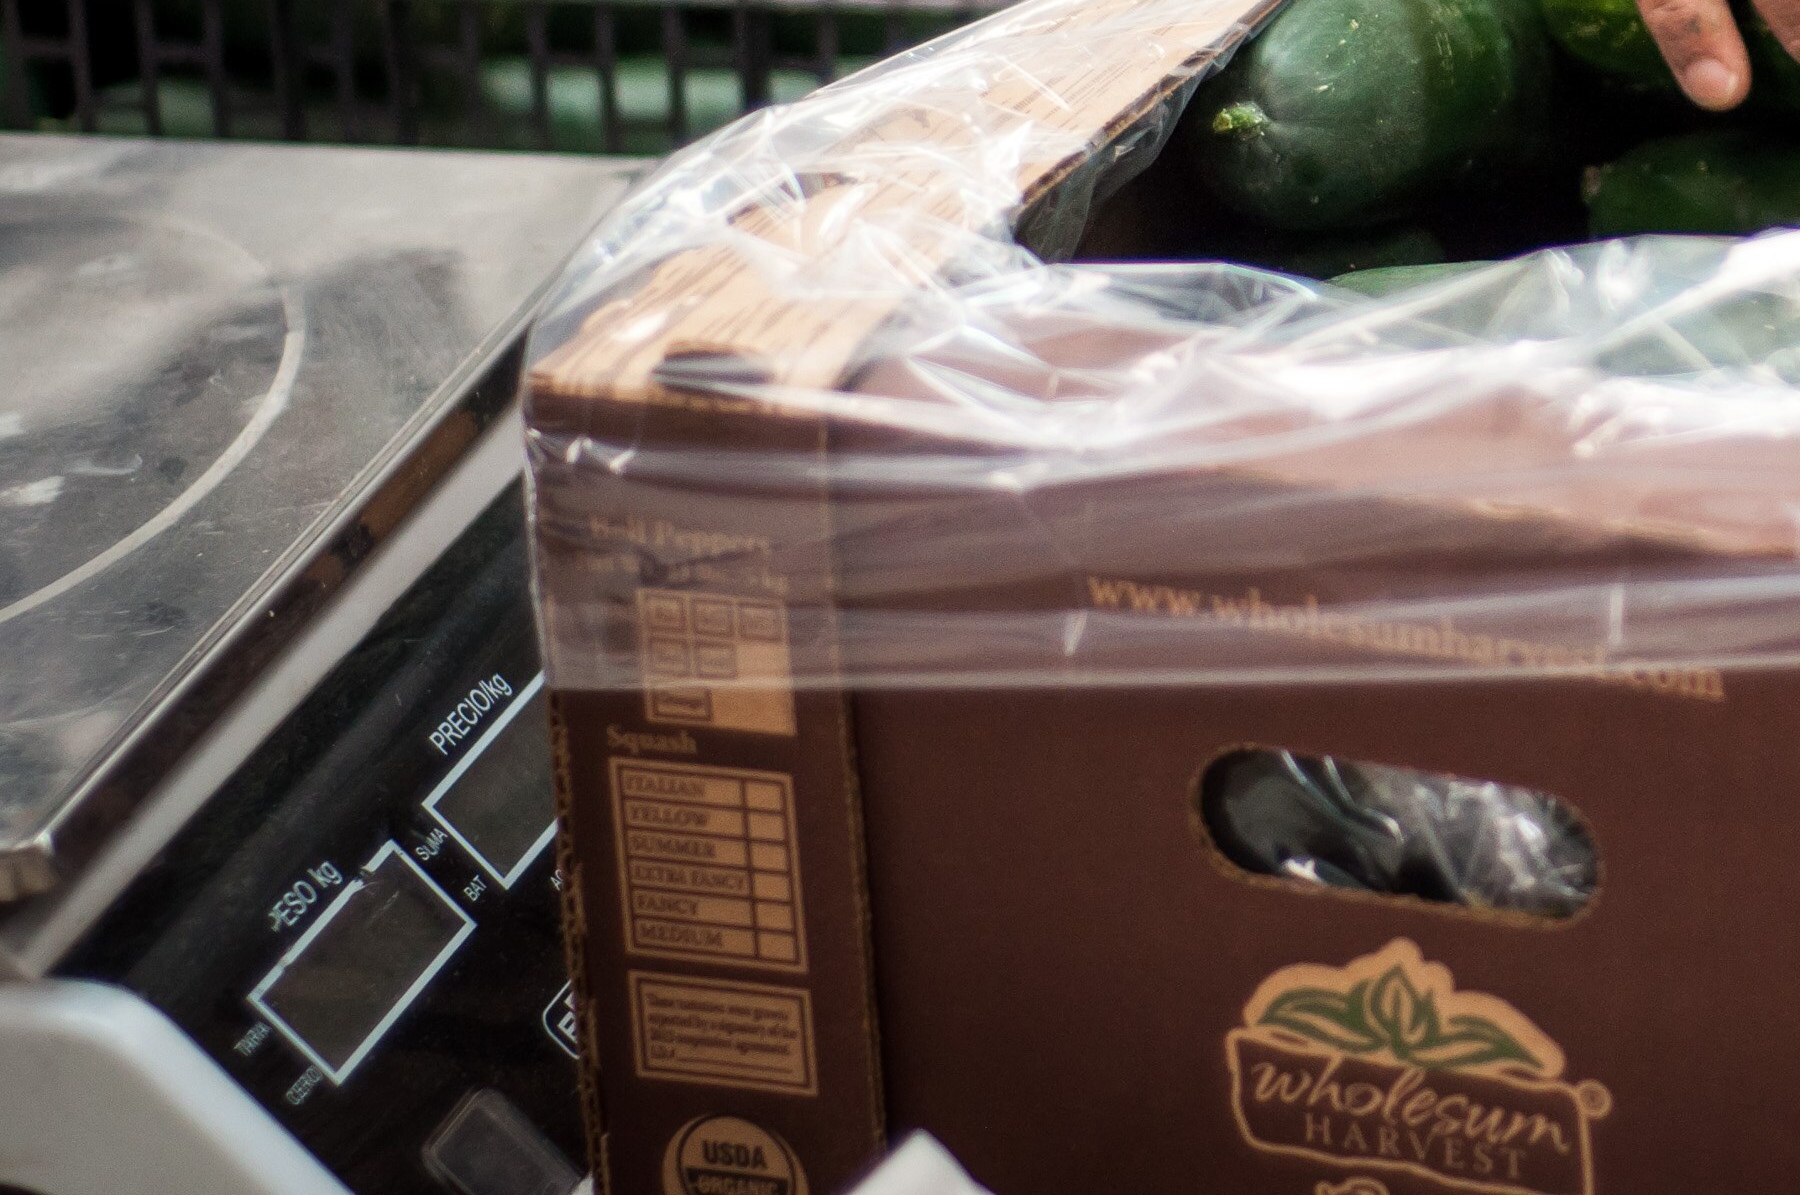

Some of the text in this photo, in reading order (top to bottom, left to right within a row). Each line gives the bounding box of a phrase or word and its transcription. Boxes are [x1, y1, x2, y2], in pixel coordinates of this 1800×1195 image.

[428, 672, 514, 755] PRECIO/kg
[606, 723, 697, 754] Squash
[631, 804, 708, 826] YELLOW
[415, 827, 448, 861] SUMA
[631, 835, 717, 859] SUMMER
[307, 860, 343, 889] kg
[463, 874, 488, 902] BAT
[637, 893, 698, 915] FANCY
[639, 921, 722, 947] MEDIUM
[1251, 1054, 1570, 1155] wholesum
[702, 1139, 768, 1170] USDA
[1304, 1113, 1527, 1181] HARVEST
